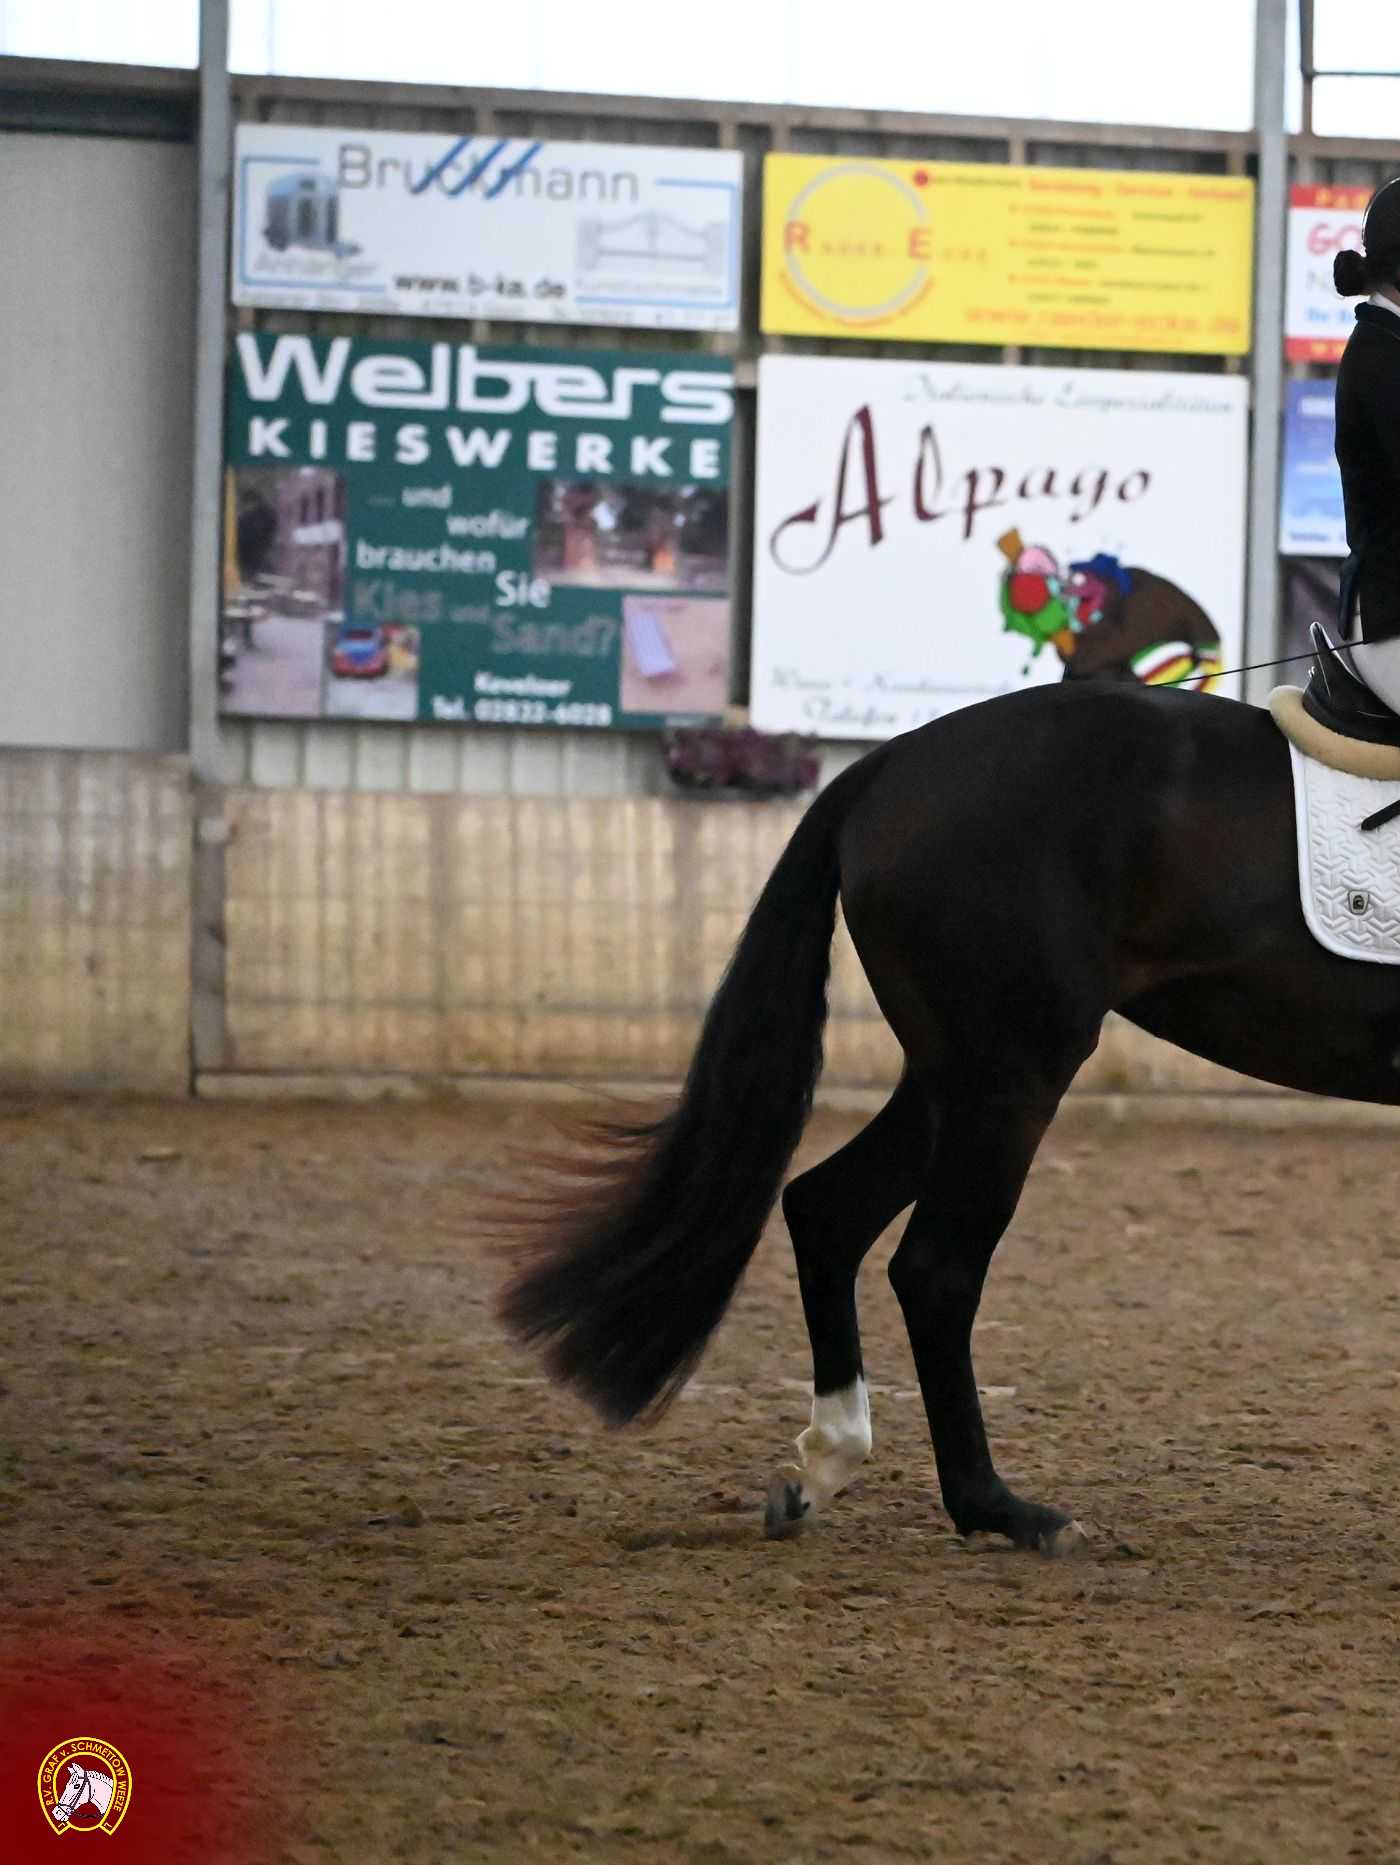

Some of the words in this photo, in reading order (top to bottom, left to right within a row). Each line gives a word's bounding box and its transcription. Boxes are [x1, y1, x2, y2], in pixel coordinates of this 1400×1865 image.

[235, 332, 735, 425] Welbers
[248, 417, 721, 479] KIESWERKE
[402, 483, 453, 509] und
[770, 404, 1153, 575] Alpago
[446, 509, 529, 539] wofür
[356, 538, 497, 574] brauchen
[353, 578, 443, 623] Kies
[495, 569, 551, 609] Sie
[491, 612, 616, 656] Sand?
